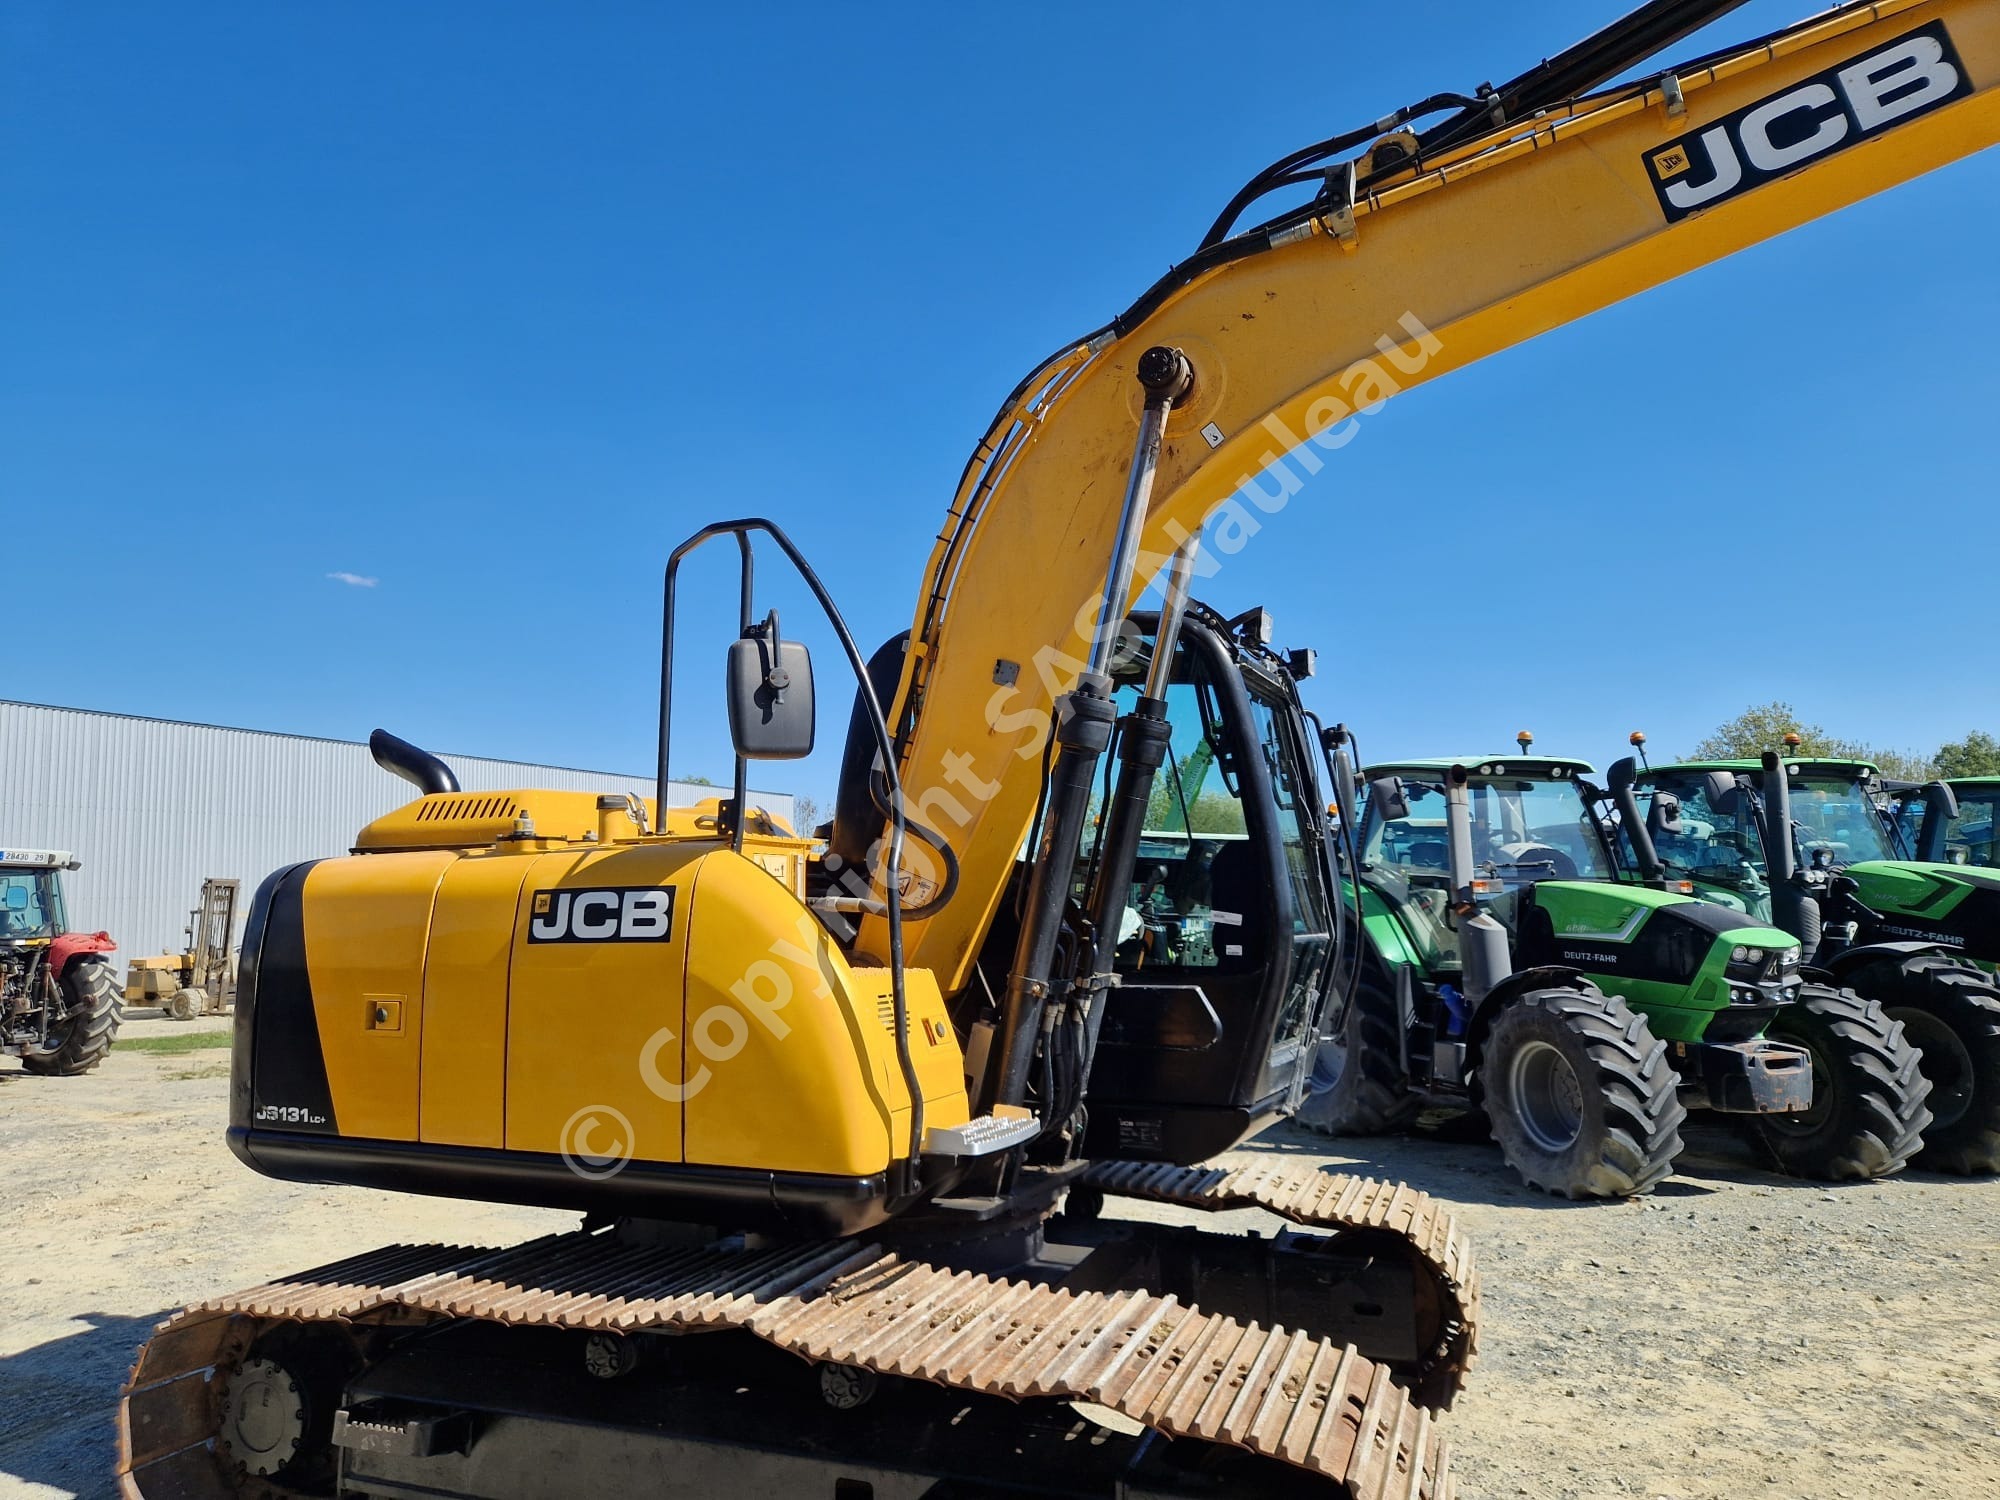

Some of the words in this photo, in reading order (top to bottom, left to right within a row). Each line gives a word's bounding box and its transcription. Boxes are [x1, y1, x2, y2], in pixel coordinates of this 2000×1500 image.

[1665, 36, 1959, 208] JCB
[1662, 152, 1685, 170] JCB
[532, 891, 669, 939] JCB
[1882, 924, 1966, 944] DEUTZ-FAHR
[1564, 951, 1617, 963] DEUTZ-FAHR
